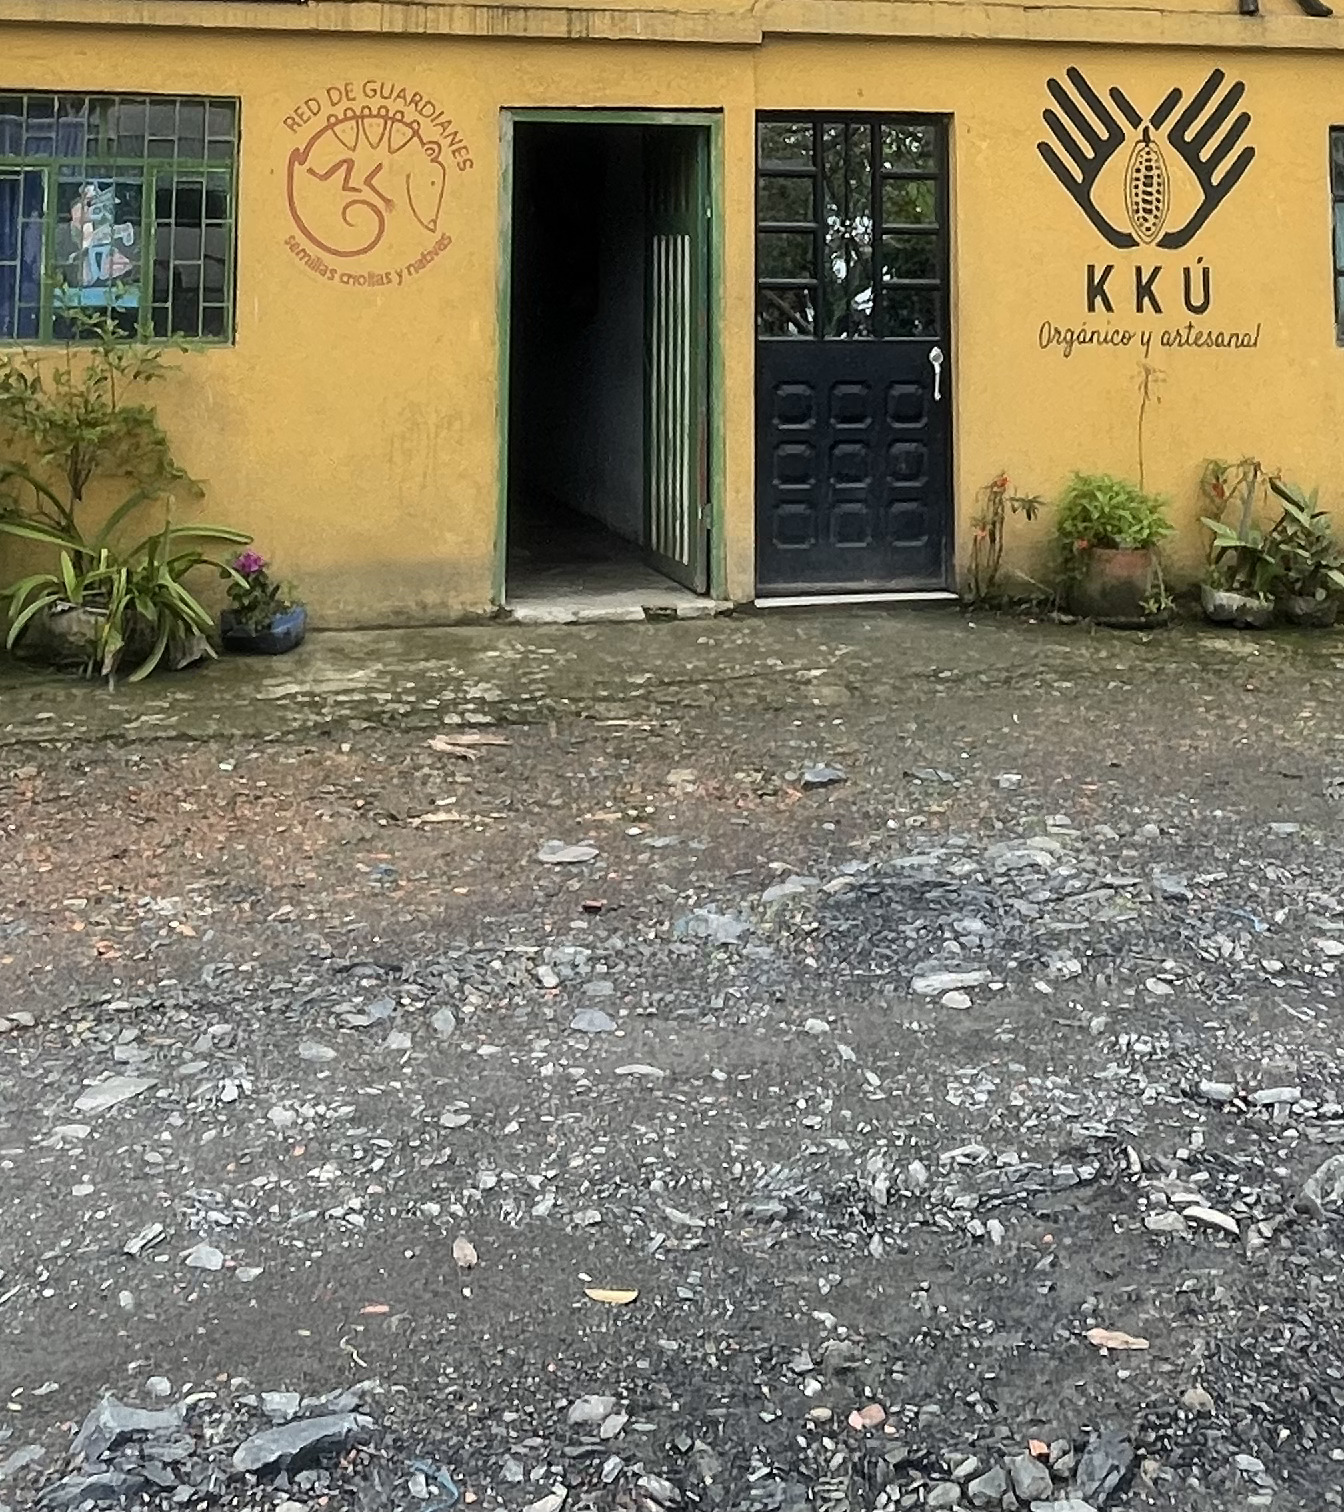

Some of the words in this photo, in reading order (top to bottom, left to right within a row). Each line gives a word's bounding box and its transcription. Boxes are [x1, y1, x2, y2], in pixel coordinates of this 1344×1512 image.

[282, 97, 321, 134] RED
[326, 82, 356, 107] DE
[362, 80, 474, 172] GUARDIANES
[394, 268, 403, 286] y
[1038, 320, 1136, 358] Orgánico
[1140, 330, 1153, 358] y
[1160, 320, 1262, 349] artesanal
